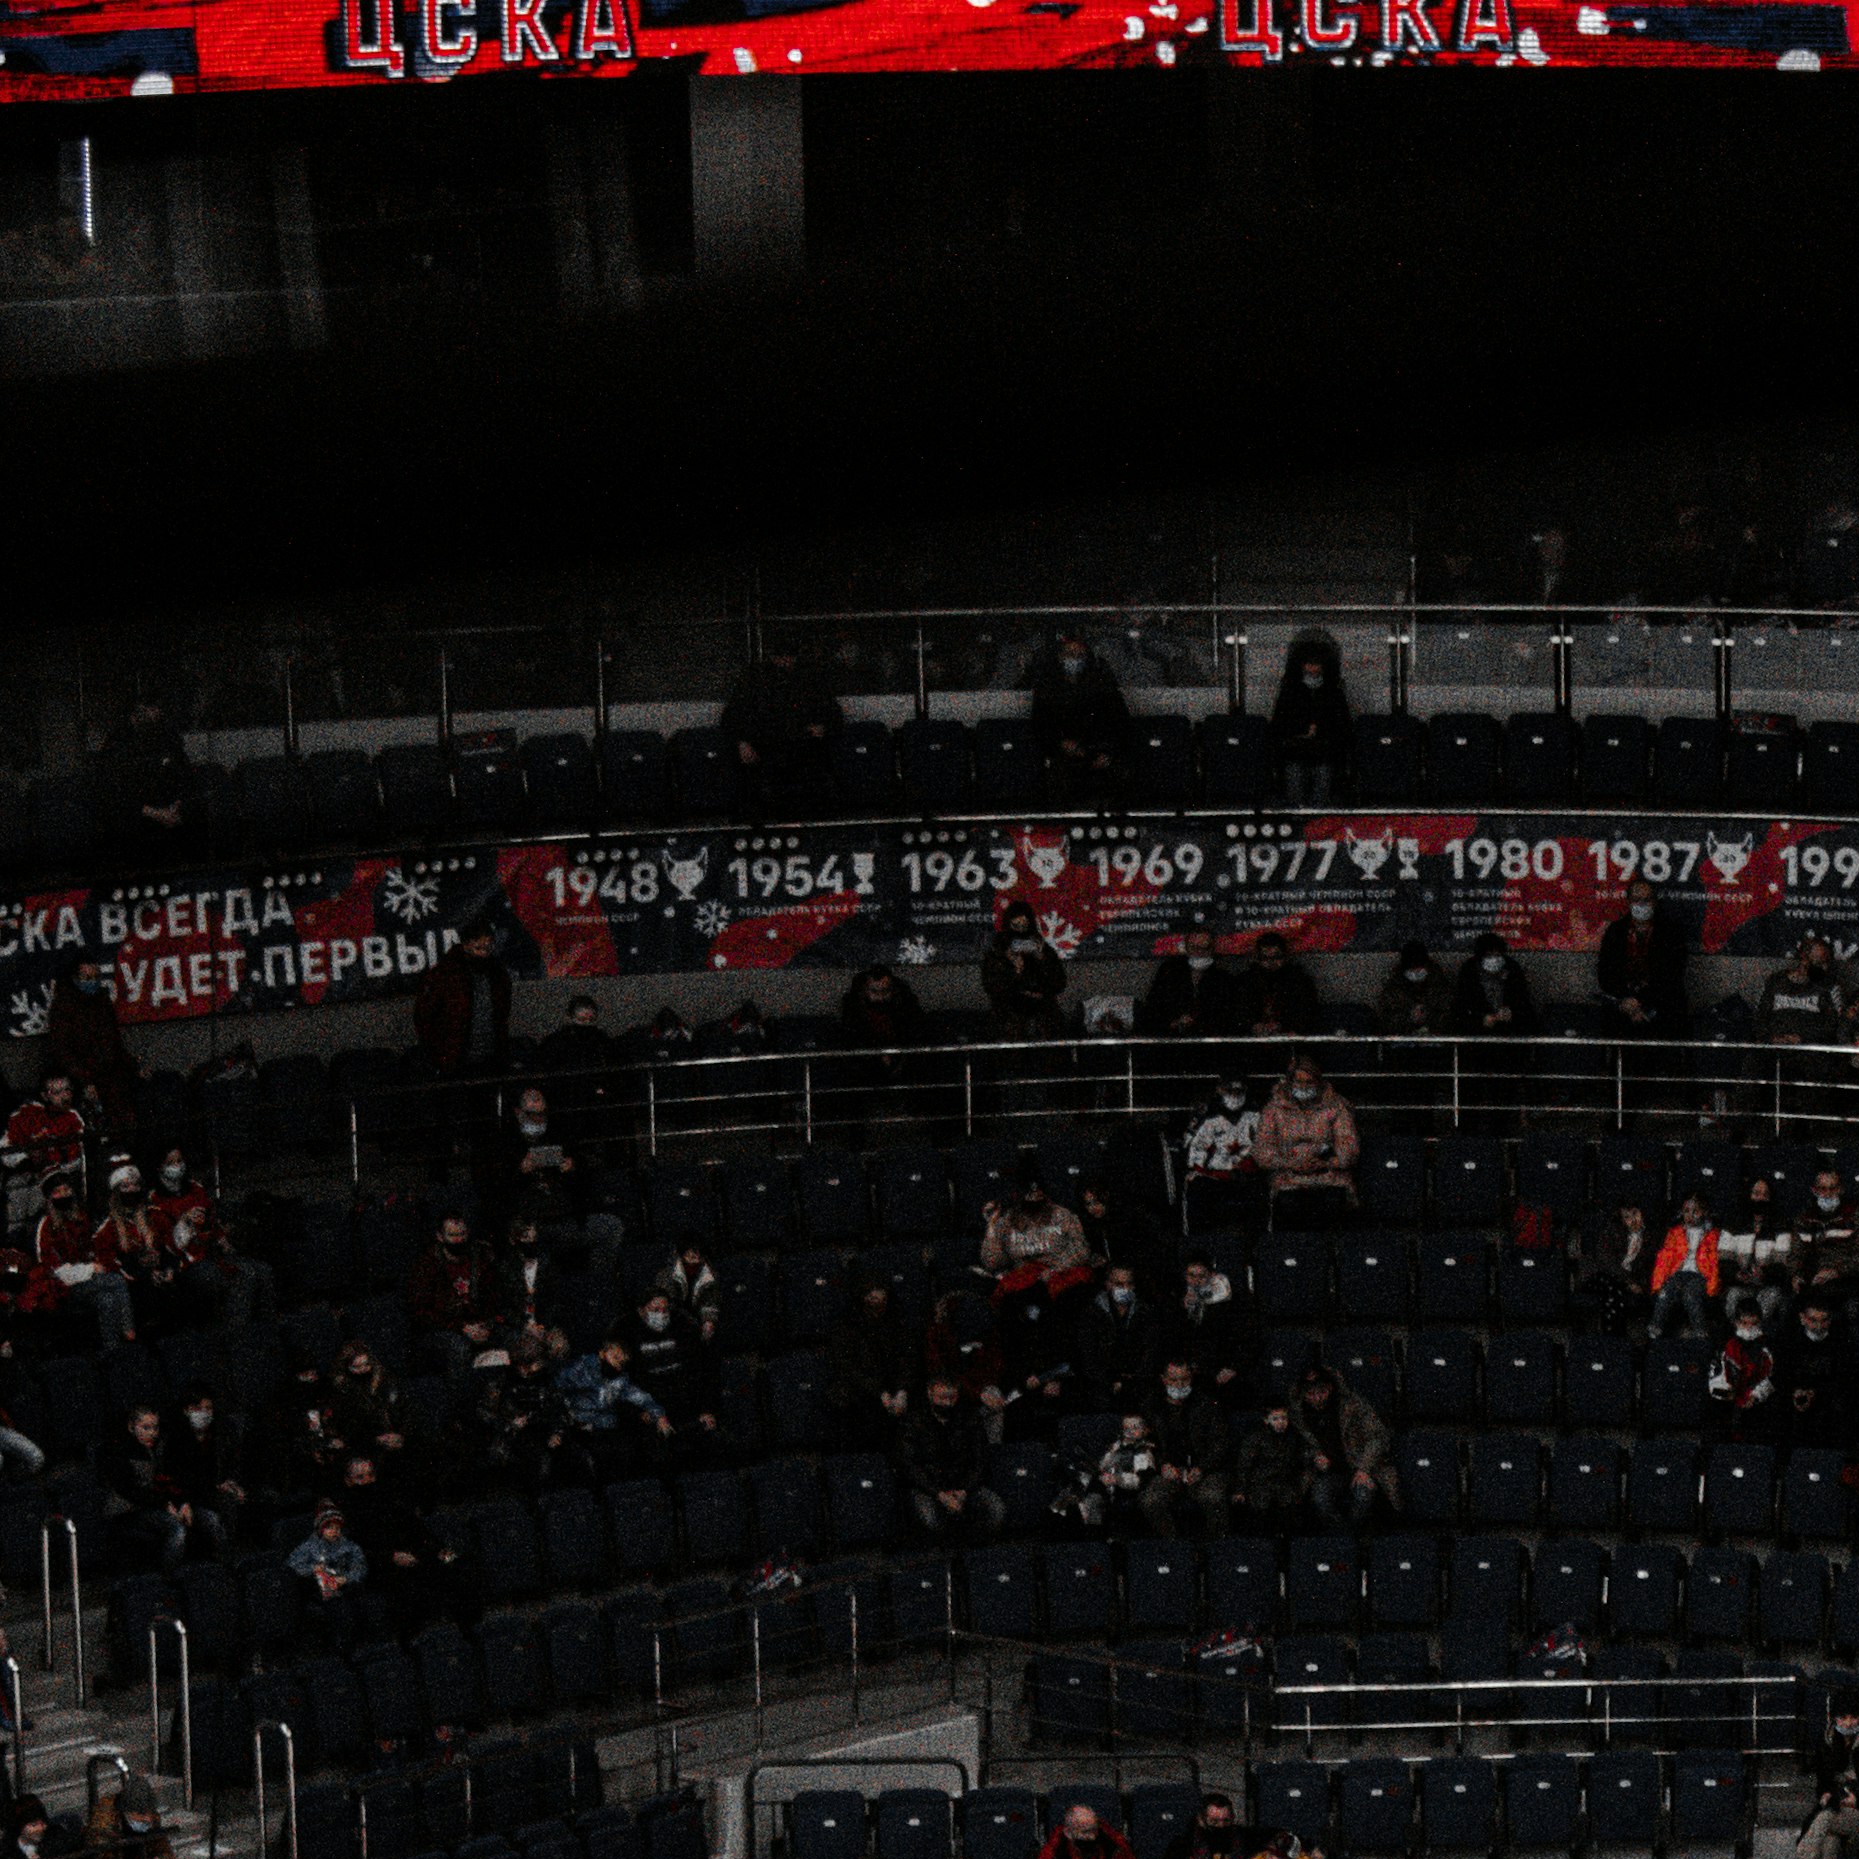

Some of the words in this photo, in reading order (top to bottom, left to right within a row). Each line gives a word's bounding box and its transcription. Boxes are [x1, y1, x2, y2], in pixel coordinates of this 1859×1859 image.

[347, 0, 635, 79] ЦСКА
[1220, 0, 1514, 63] ЦСКА
[727, 854, 845, 899] 1954
[901, 847, 1019, 893] 1963
[1087, 842, 1205, 888] 1969
[1225, 839, 1340, 884] 1977
[1444, 838, 1564, 883] 1980
[1586, 840, 1700, 884] 1987
[545, 861, 660, 908] 1948
[100, 885, 295, 946] ВСЕГДА
